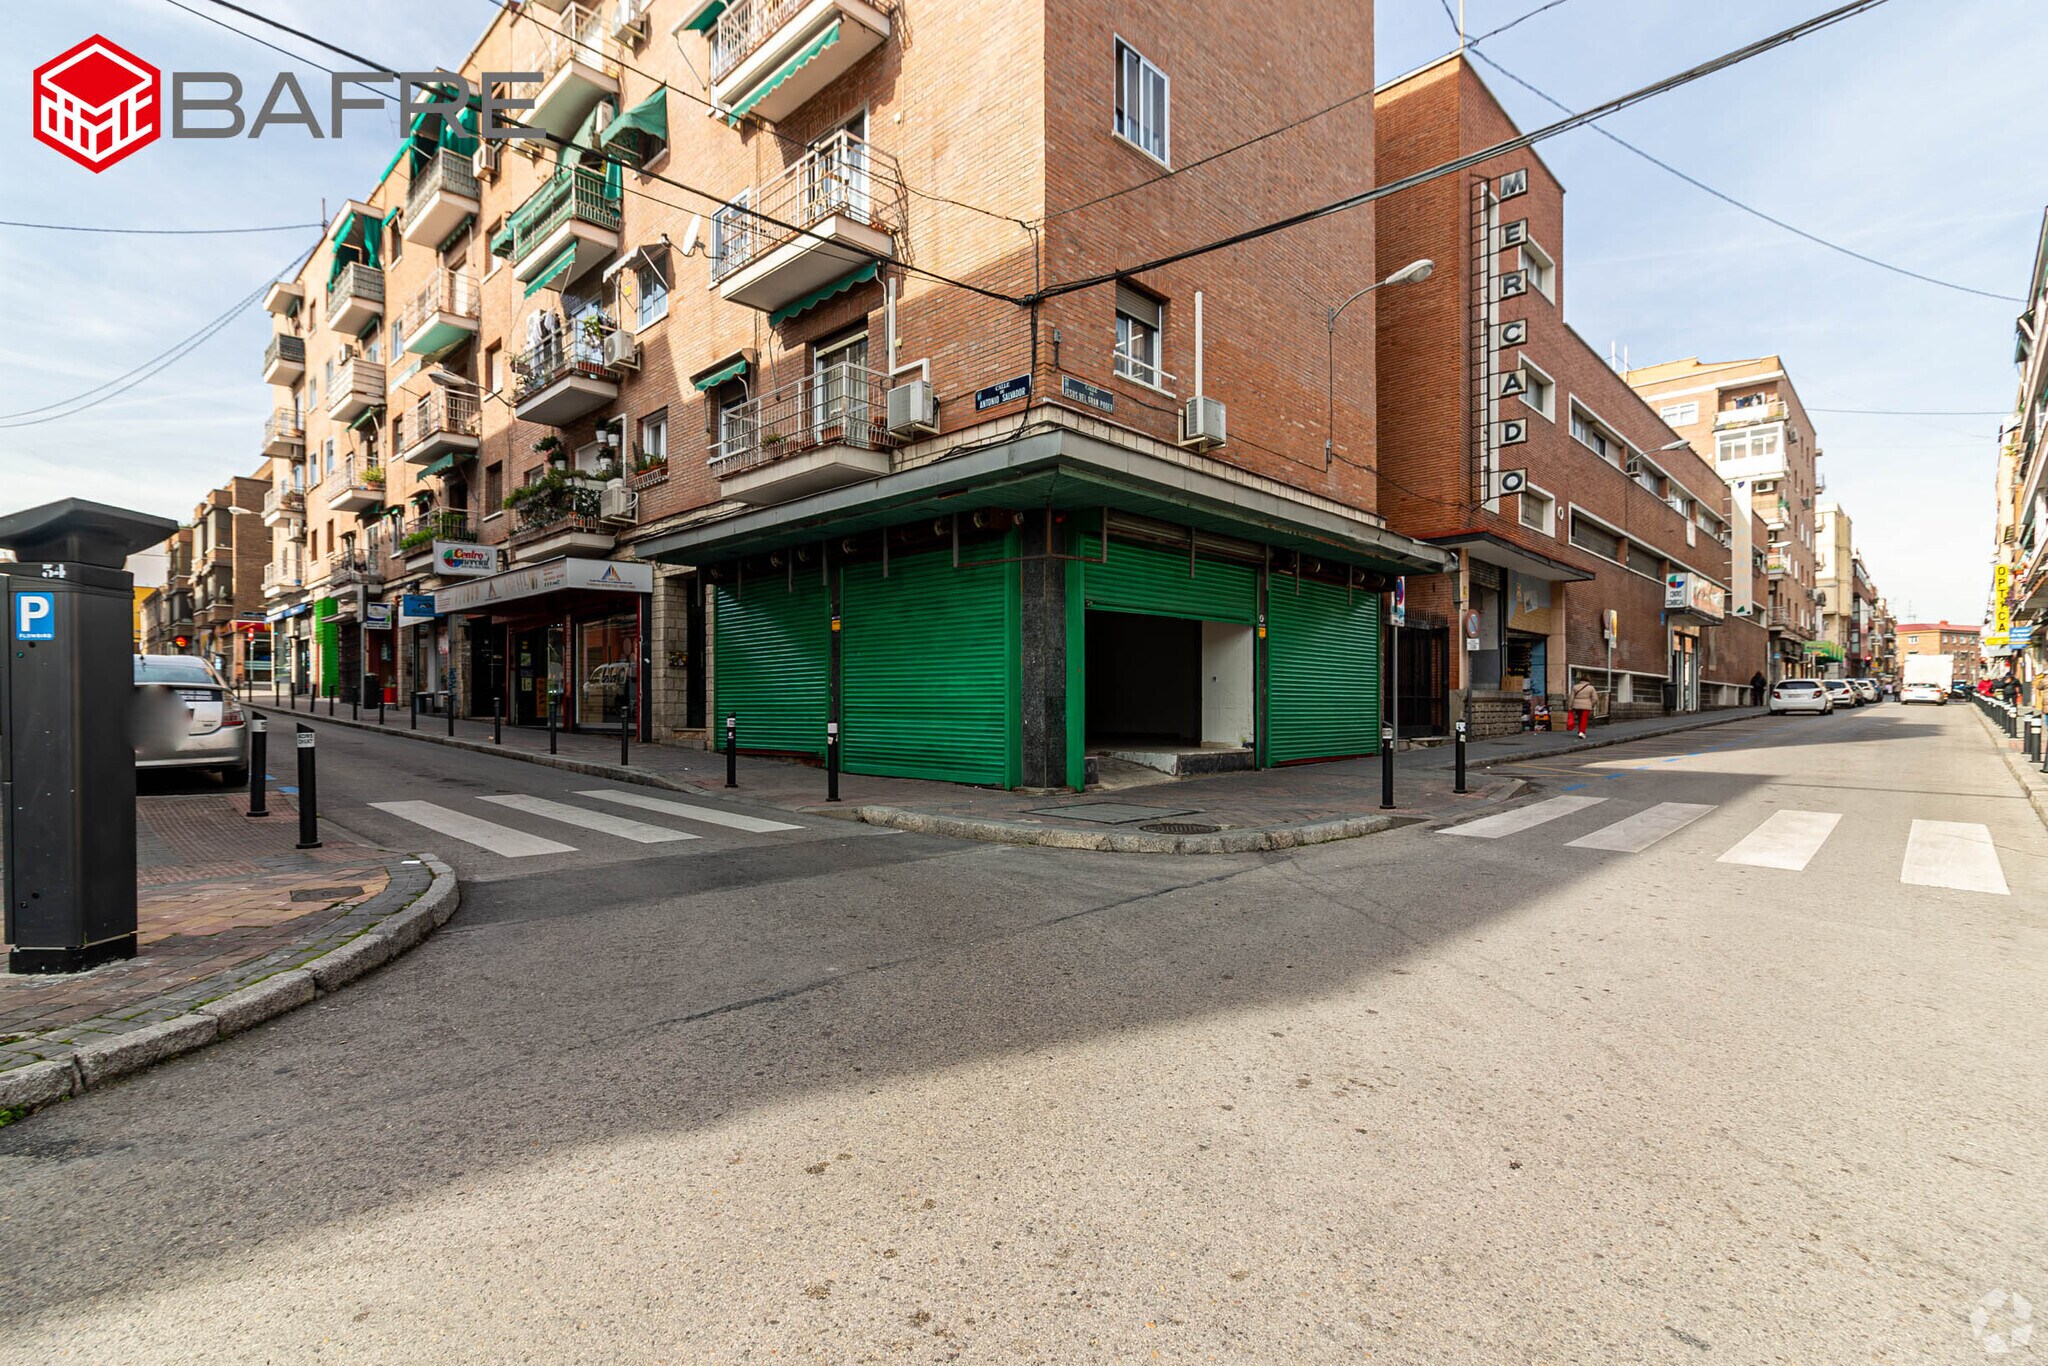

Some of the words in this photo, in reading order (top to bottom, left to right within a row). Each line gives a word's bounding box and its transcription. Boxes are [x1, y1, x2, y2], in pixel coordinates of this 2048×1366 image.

[1501, 173, 1525, 490] MERCADO
[995, 381, 1011, 391] CALLE
[1084, 384, 1098, 394] CALLE
[979, 395, 1000, 409] ANTONIO
[1002, 386, 1026, 402] SALVADOR
[1078, 391, 1087, 403] DEL
[1088, 395, 1099, 406] GRAN
[454, 548, 483, 559] Centro
[41, 563, 67, 578] 54
[20, 595, 50, 632] P
